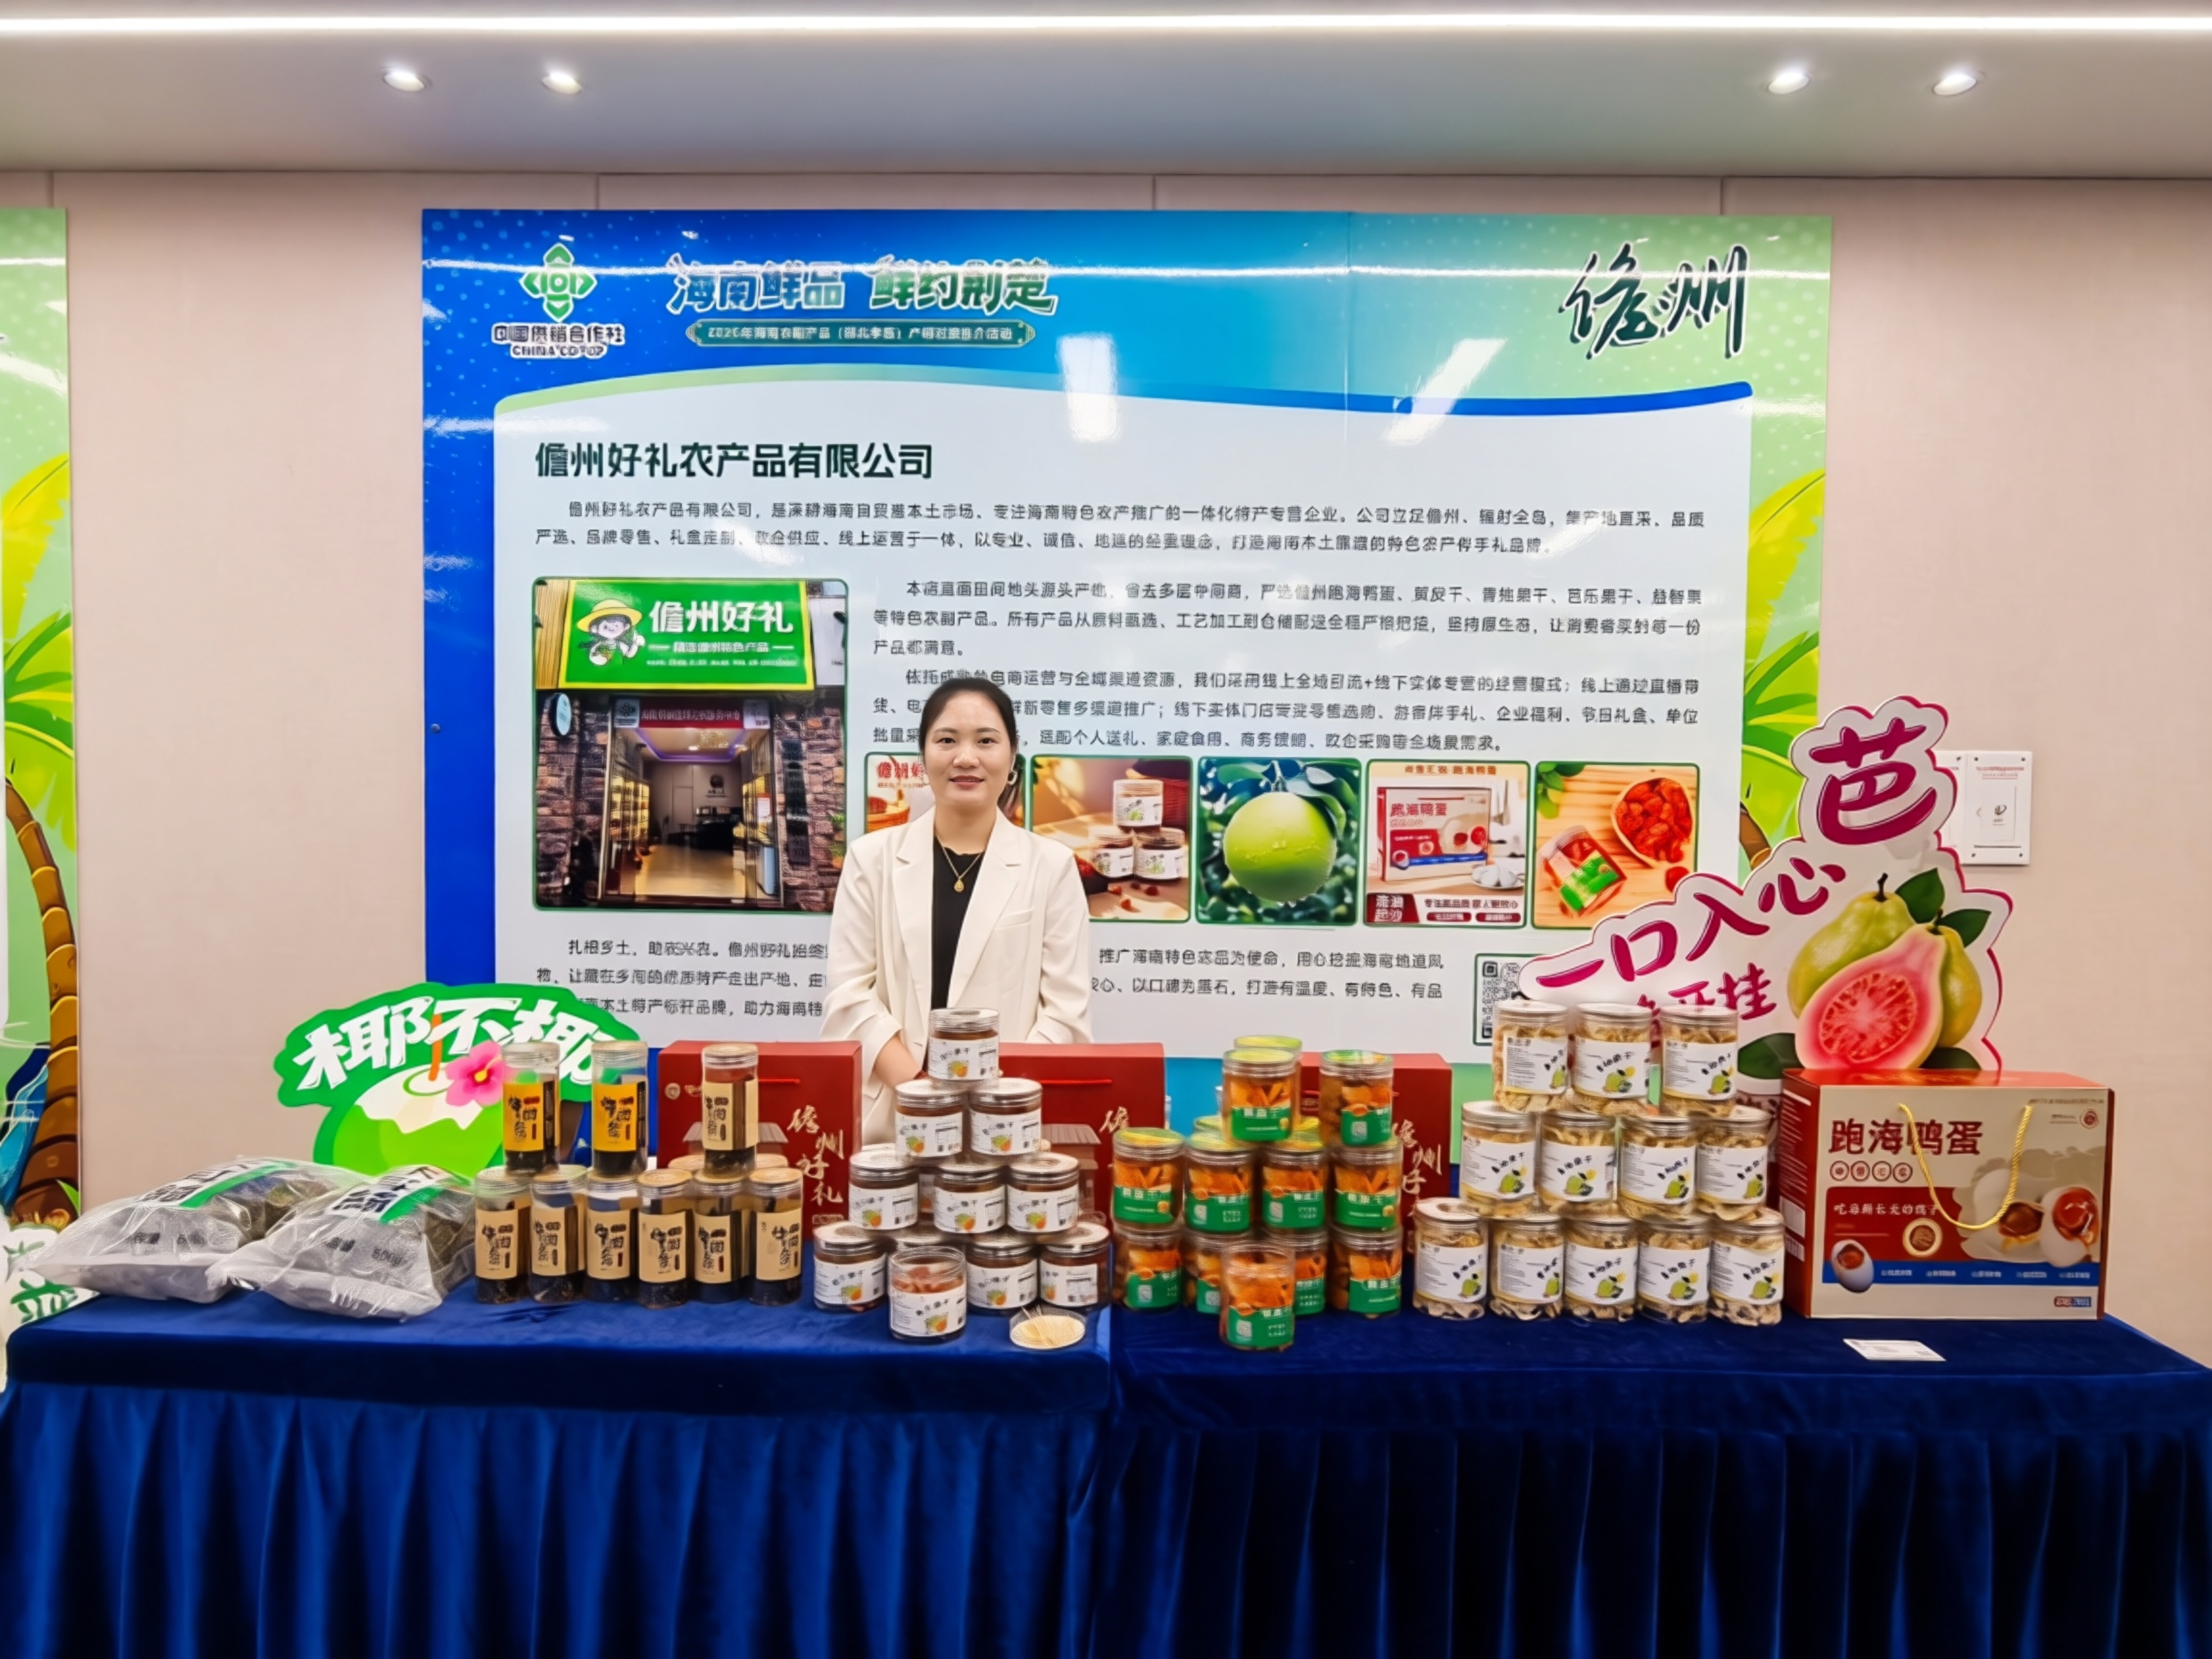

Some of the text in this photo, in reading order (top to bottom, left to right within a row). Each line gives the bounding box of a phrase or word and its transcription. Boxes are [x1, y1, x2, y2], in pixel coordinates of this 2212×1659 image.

[493, 325, 623, 343] 中国供销合作社
[513, 346, 556, 356] CHINA
[535, 442, 933, 479] 儋州好礼农产品有限公司
[650, 601, 793, 633] 儋州好礼
[874, 640, 963, 656] 产品都满意。
[874, 697, 927, 714] 货、电
[1810, 717, 1937, 845] 芭
[1390, 802, 1447, 817] 跑海鸭蛋
[1536, 857, 1847, 988] 一口入心
[568, 939, 828, 959] 扎根乡土，助农兴农。儋州好礼始终
[537, 967, 827, 988] 物，让藏在乡间的优质特产走出产地、走
[577, 997, 823, 1017] 南本土特产标杆品牌，助力海南特
[1828, 1119, 1983, 1155] 跑海鸭蛋
[787, 1104, 844, 1205] 儋州好礼
